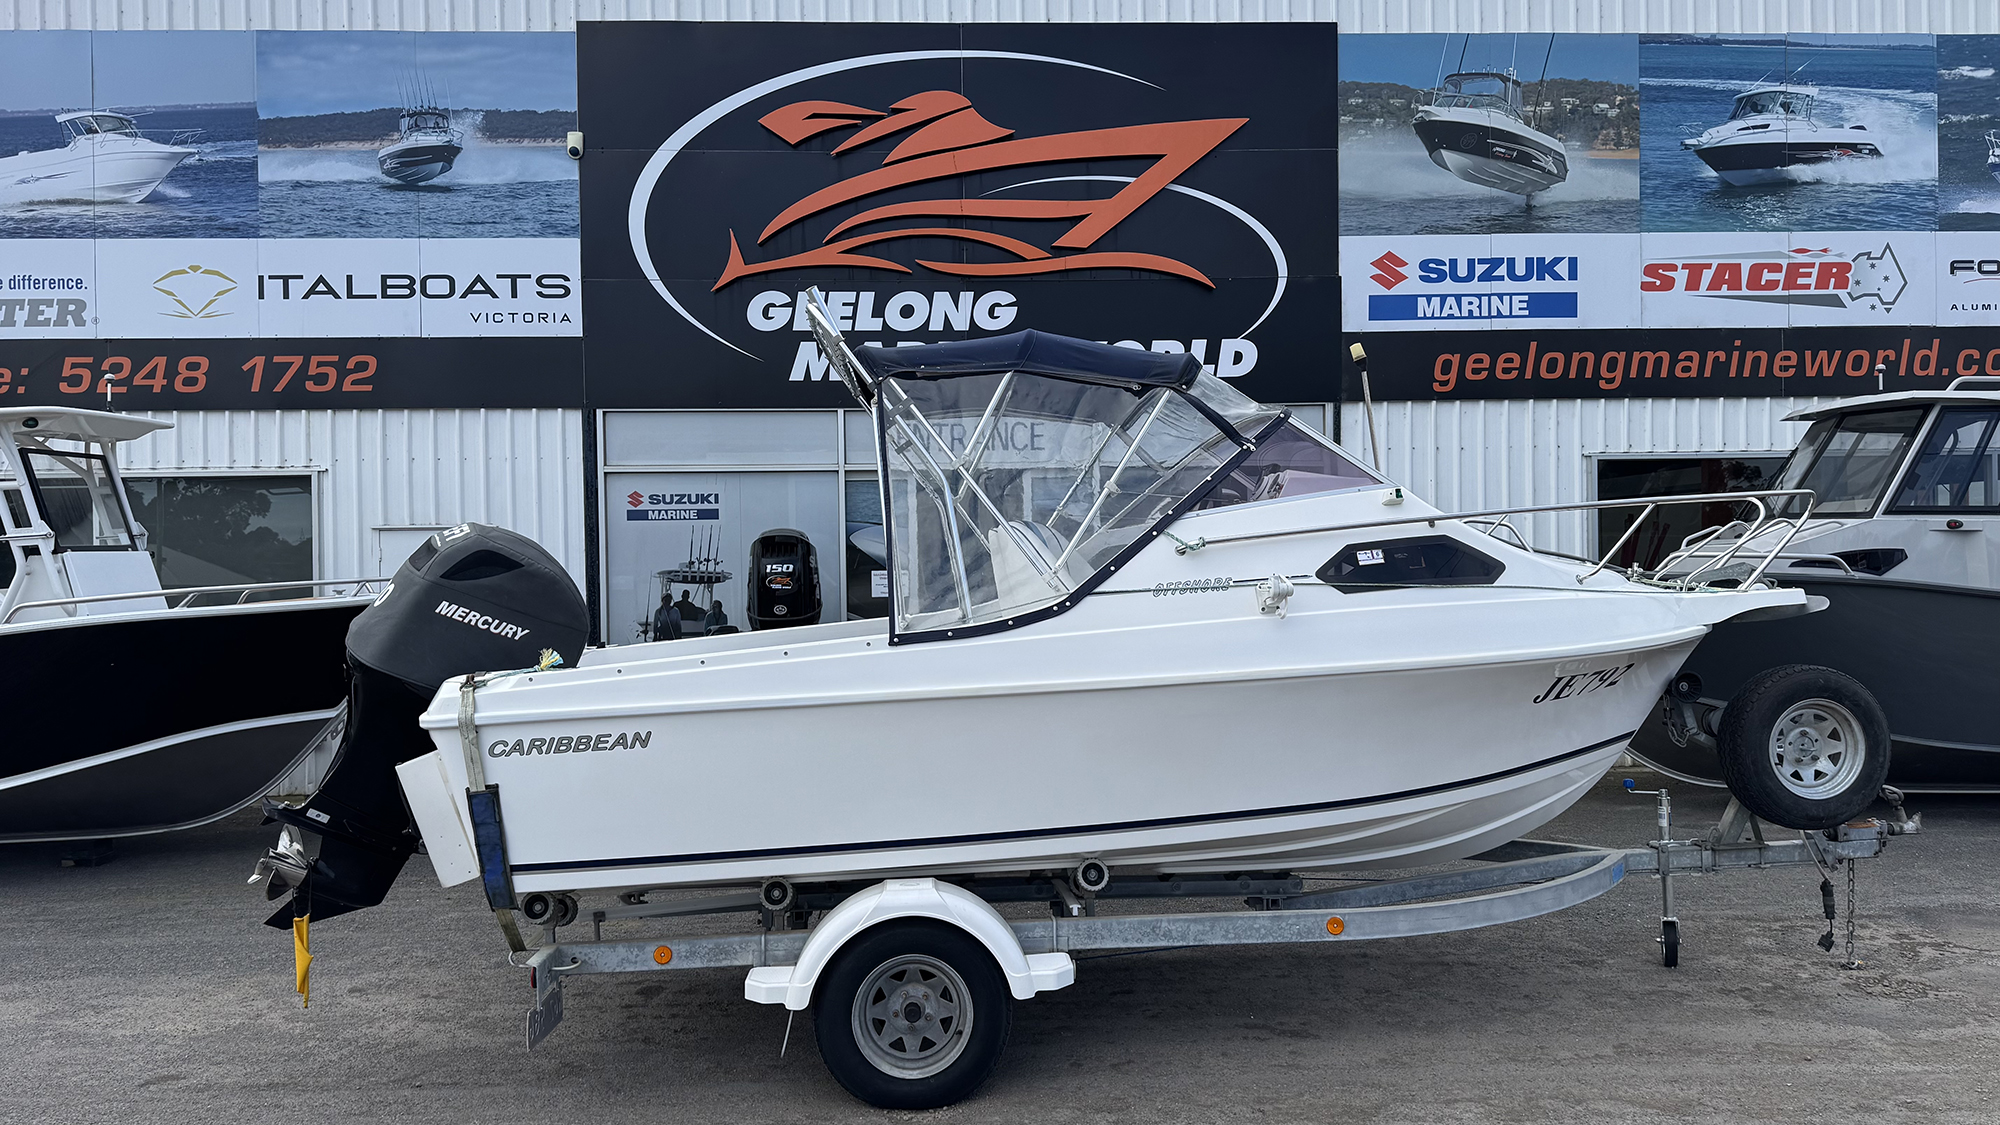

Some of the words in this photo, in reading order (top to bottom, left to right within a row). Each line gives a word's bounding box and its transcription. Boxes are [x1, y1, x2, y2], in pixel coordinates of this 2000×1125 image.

[8, 275, 88, 290] difference.
[1417, 256, 1578, 283] SUZUKI
[1640, 261, 1853, 291] STACER
[257, 273, 572, 300] ITALBOATS
[469, 312, 572, 324] VICTORIA
[1416, 295, 1529, 318] MARINE
[58, 355, 210, 394] 5248
[241, 355, 378, 392] 1752
[648, 493, 719, 505] SUZUKI
[648, 510, 698, 520] MARINE
[766, 563, 794, 573] 150
[434, 600, 530, 641] MERCURY
[1532, 662, 1635, 704] JE792
[487, 730, 652, 758] CARIBBEAN
